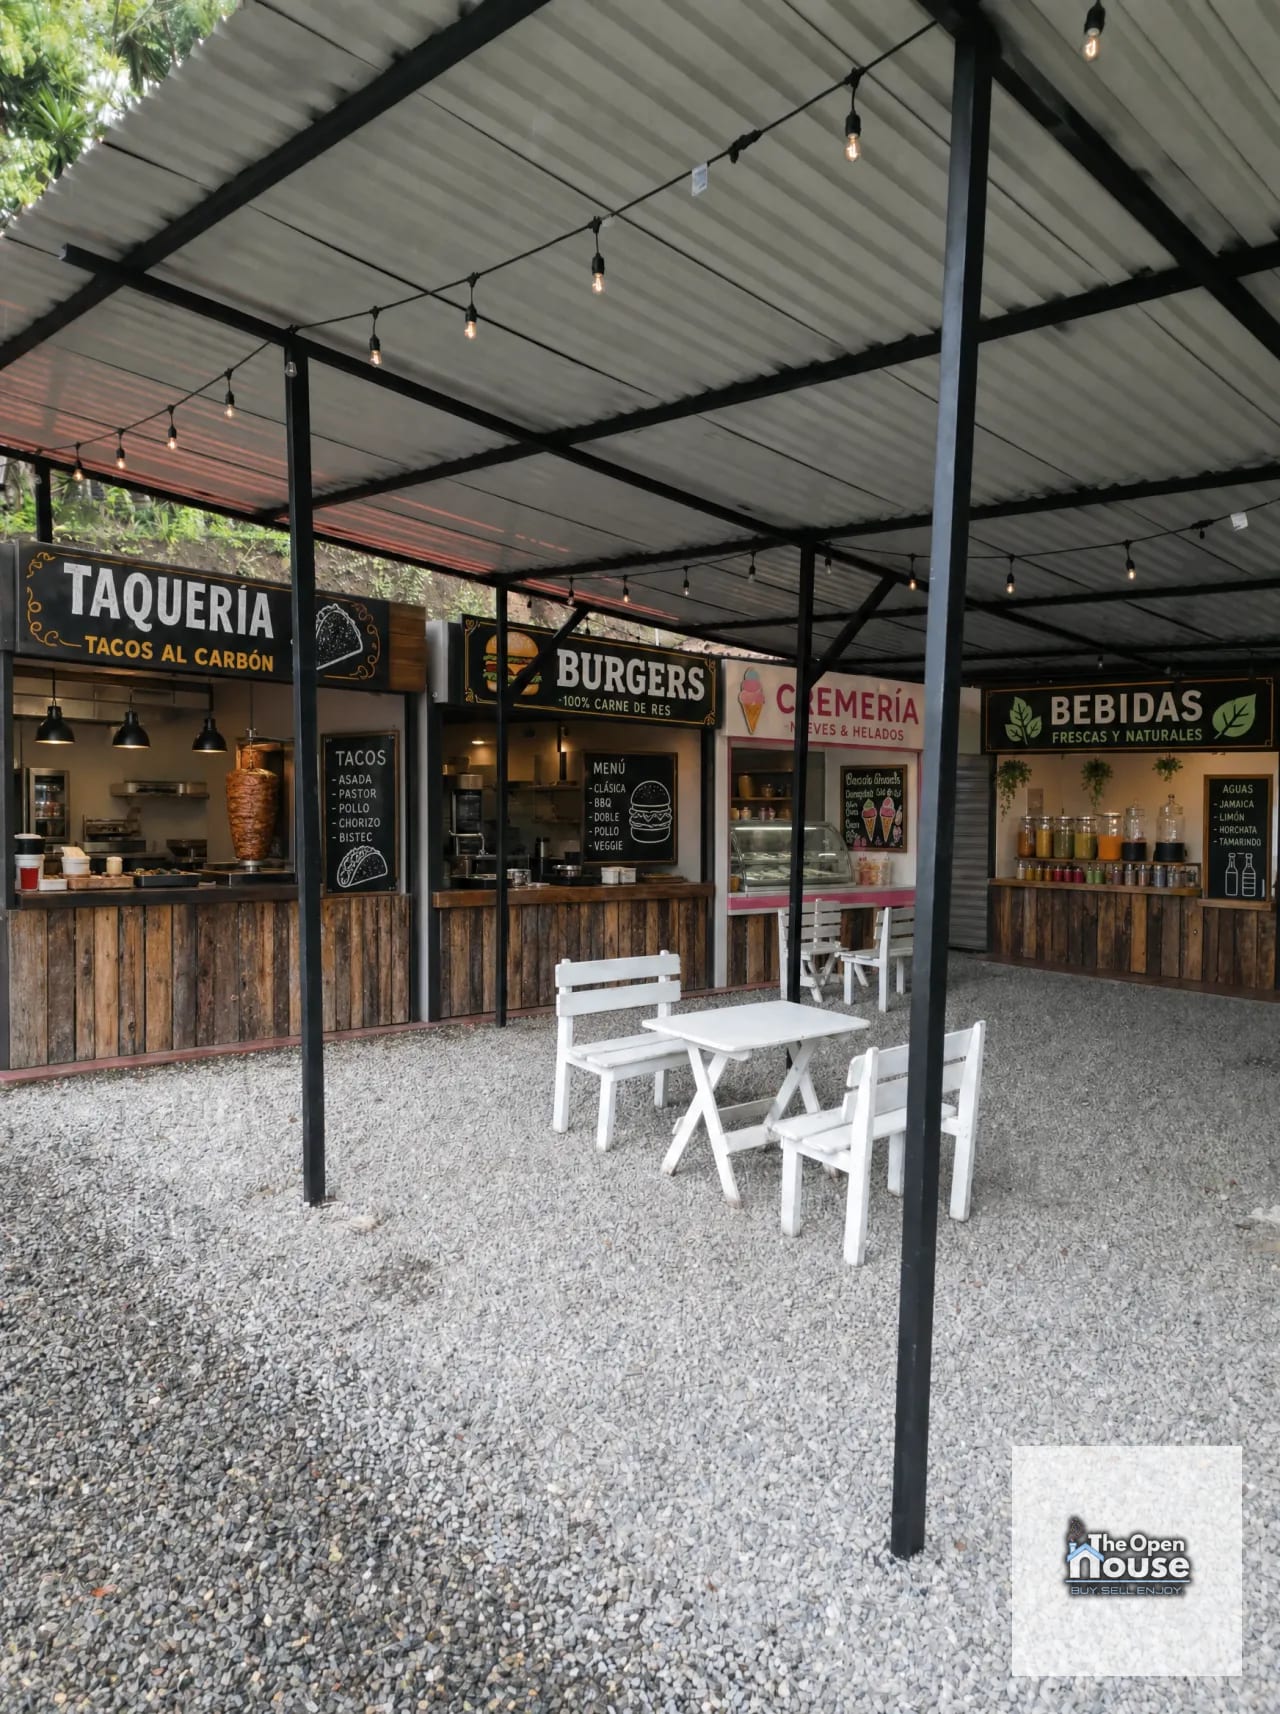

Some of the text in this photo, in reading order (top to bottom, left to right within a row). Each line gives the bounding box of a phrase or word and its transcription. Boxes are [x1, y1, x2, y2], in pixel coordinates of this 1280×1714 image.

[63, 562, 274, 639] TAQUERÍA
[85, 635, 274, 672] TACOS AL CARBÓN
[556, 648, 705, 702] BURGERS
[594, 698, 629, 713] CARNE
[633, 701, 646, 714] DE
[651, 703, 671, 717] RES
[1051, 689, 1203, 725] BEBIDAS
[840, 725, 848, 737] &
[853, 726, 904, 741] HELADOS
[1052, 728, 1203, 744] FRESCAS Y NATURALES
[336, 750, 386, 766] TACOS
[593, 758, 626, 775] MENÚ
[1222, 784, 1254, 794] AGUAS
